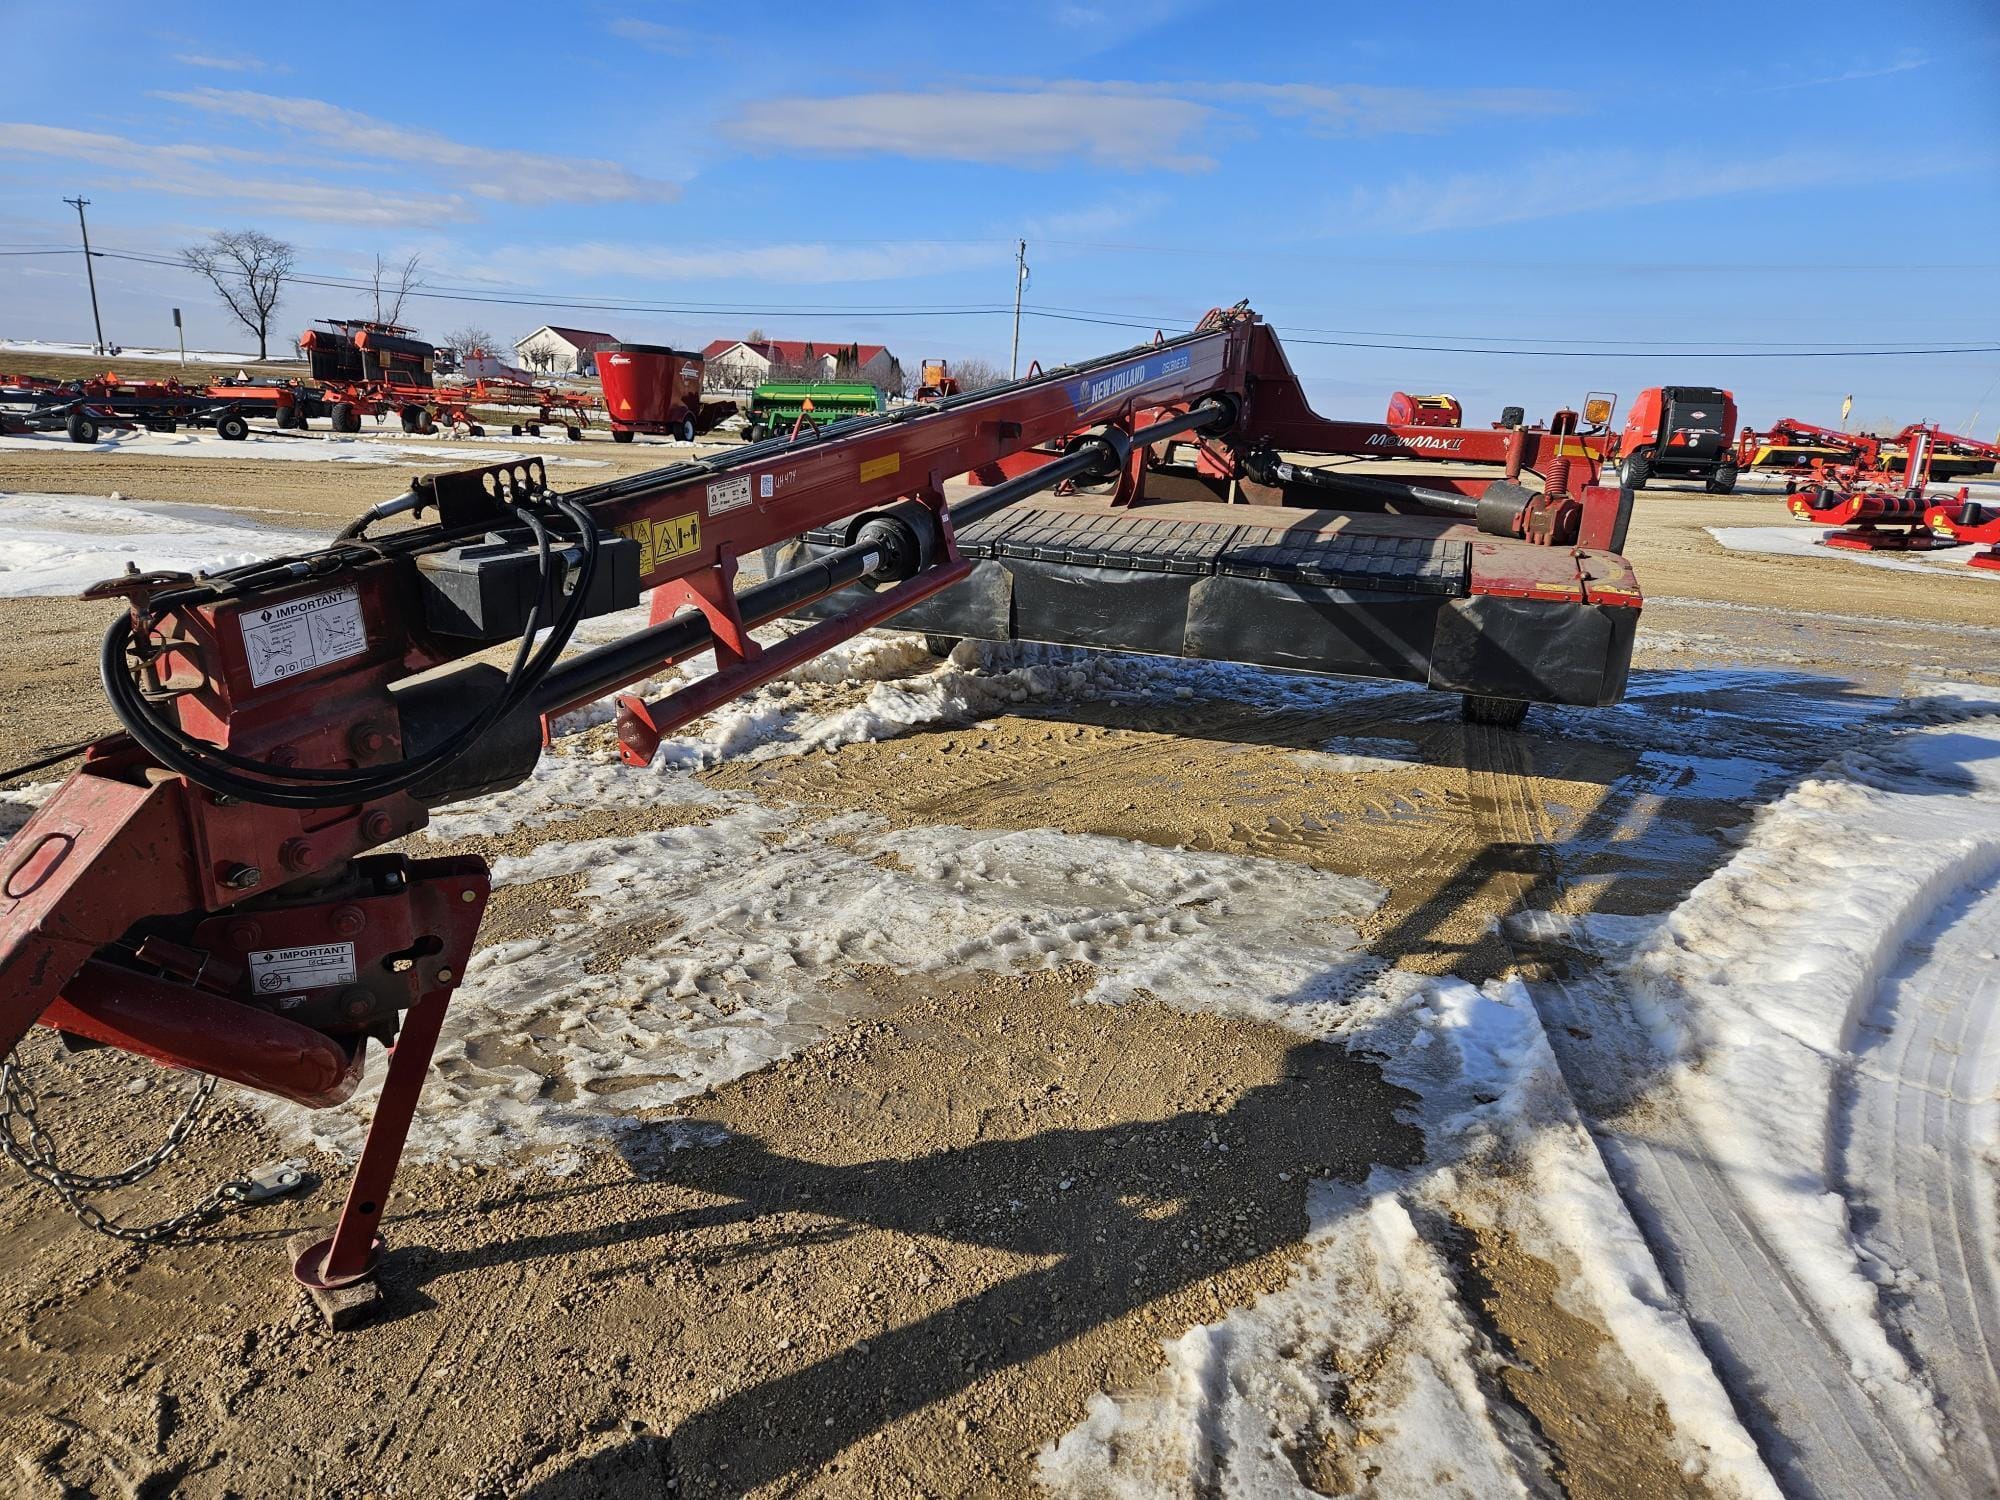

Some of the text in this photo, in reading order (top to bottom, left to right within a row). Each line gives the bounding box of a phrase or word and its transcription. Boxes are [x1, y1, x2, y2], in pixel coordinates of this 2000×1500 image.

[1091, 365, 1145, 403] NEW HOLLAND
[276, 592, 343, 619] IMPORTANT
[280, 946, 346, 960] IMPORTANT
